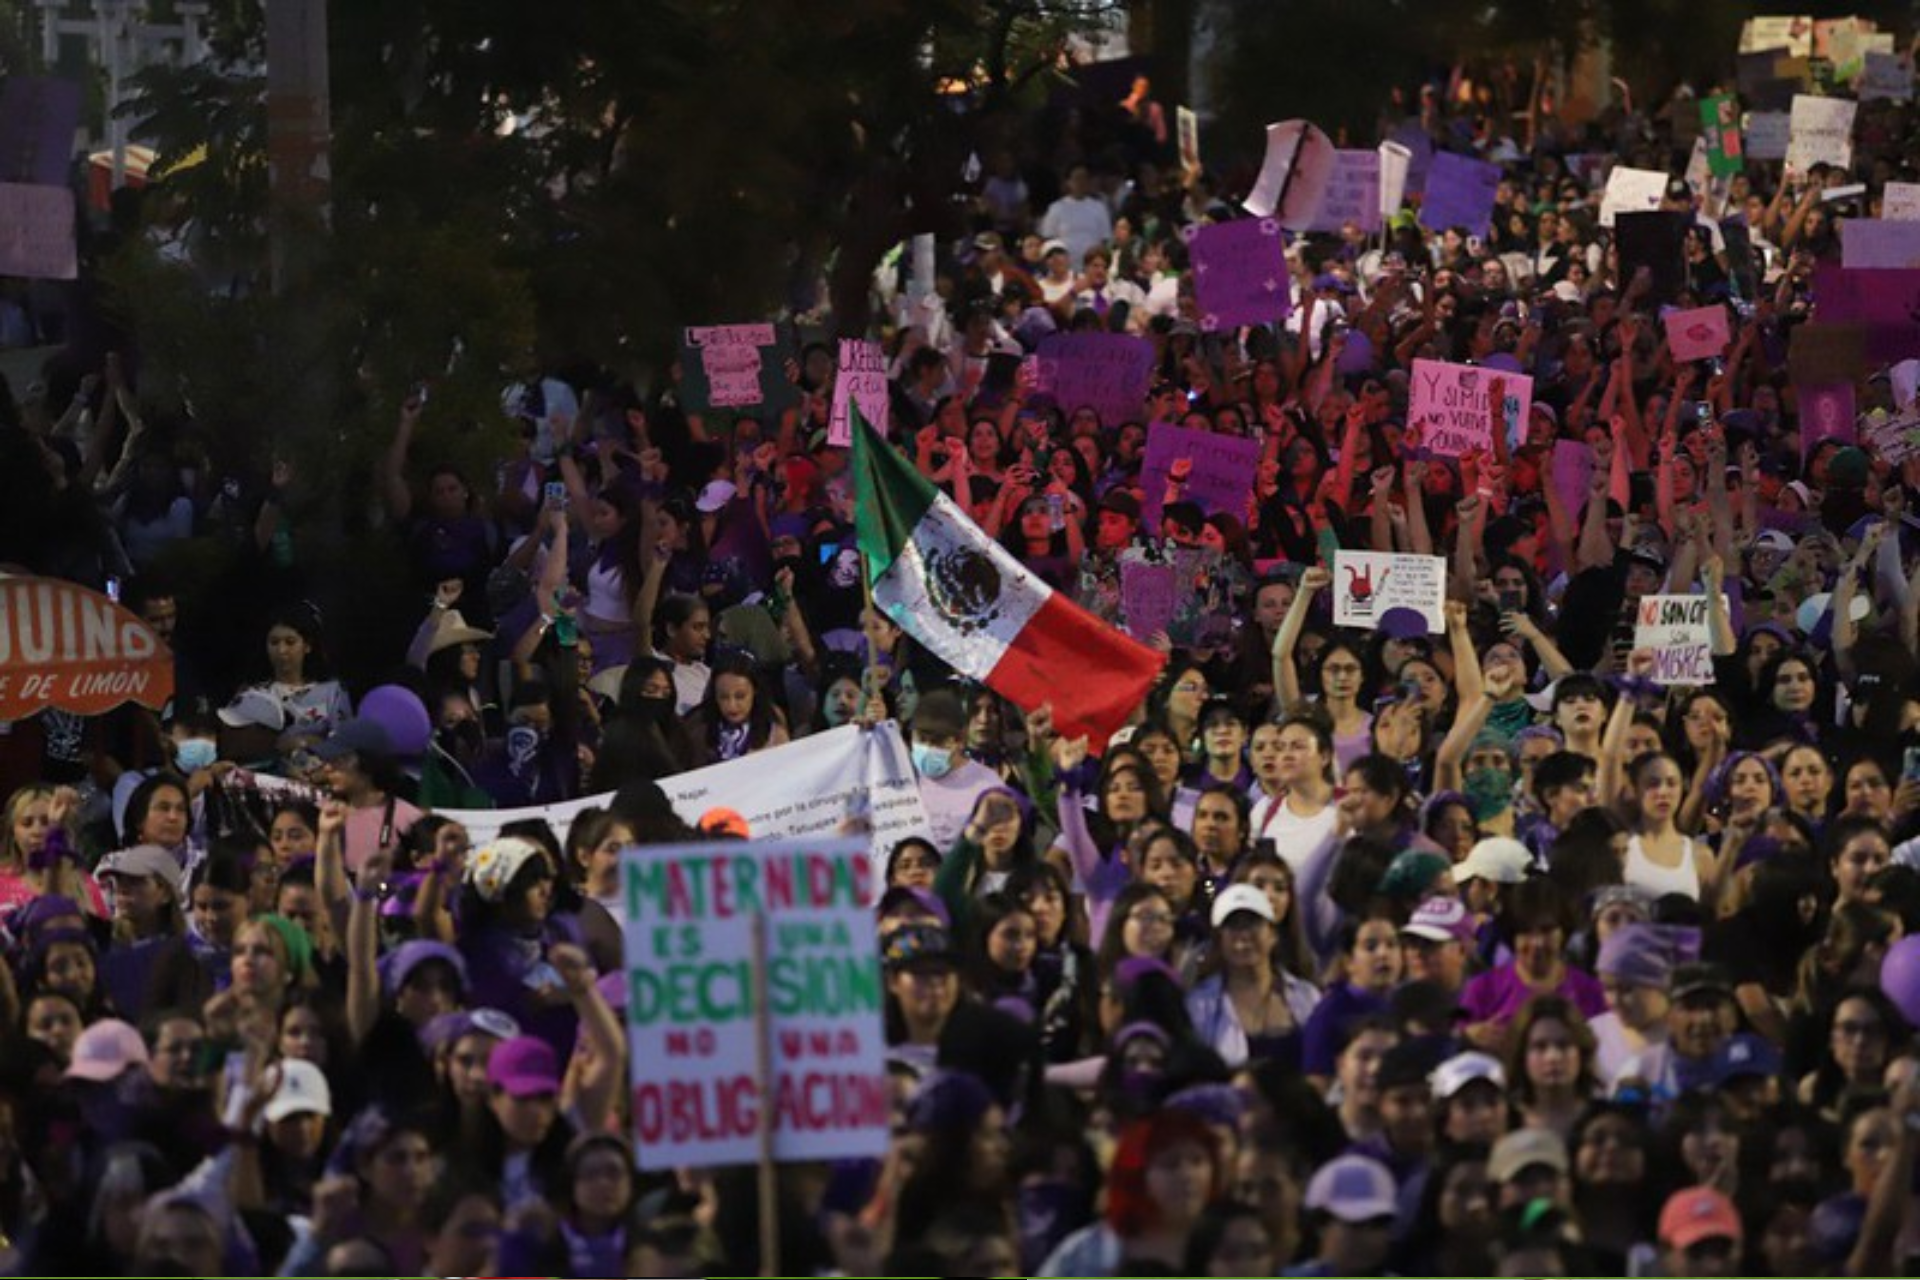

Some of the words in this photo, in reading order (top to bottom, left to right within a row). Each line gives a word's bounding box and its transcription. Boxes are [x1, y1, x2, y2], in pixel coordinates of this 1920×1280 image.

[1423, 371, 1441, 403] Y
[1427, 412, 1445, 425] NO
[1640, 599, 1659, 627] NO
[19, 673, 58, 699] DE
[68, 662, 150, 698] LIMÓN
[653, 923, 703, 958] ES
[778, 920, 851, 950] UNA
[665, 1027, 717, 1057] NO
[780, 1028, 861, 1061] UNA
